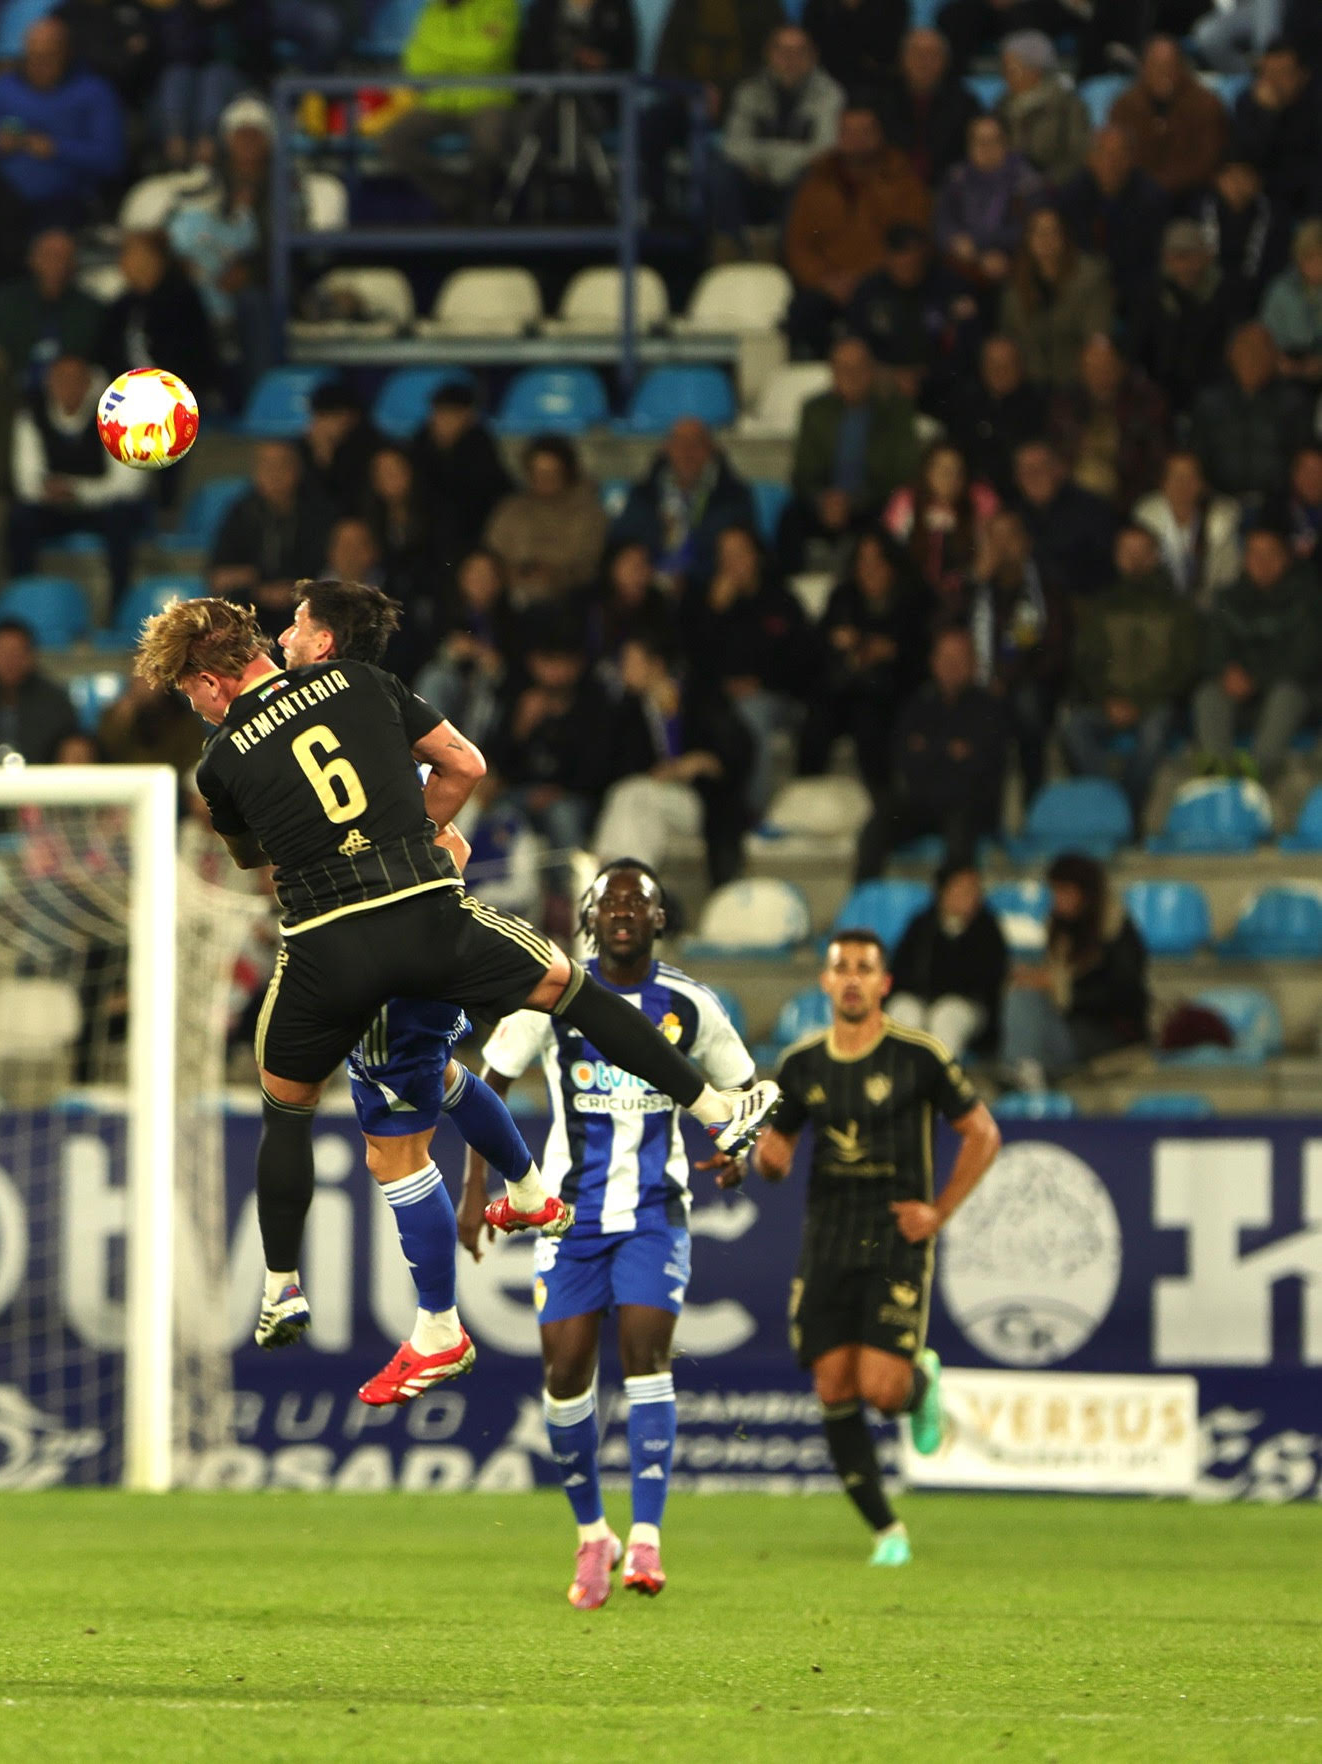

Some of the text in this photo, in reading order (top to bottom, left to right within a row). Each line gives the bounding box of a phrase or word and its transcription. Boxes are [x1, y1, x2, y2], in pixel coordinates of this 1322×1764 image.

[230, 669, 351, 755] REMENTERIA
[291, 724, 368, 824] 6
[575, 1094, 672, 1113] CRICURSA
